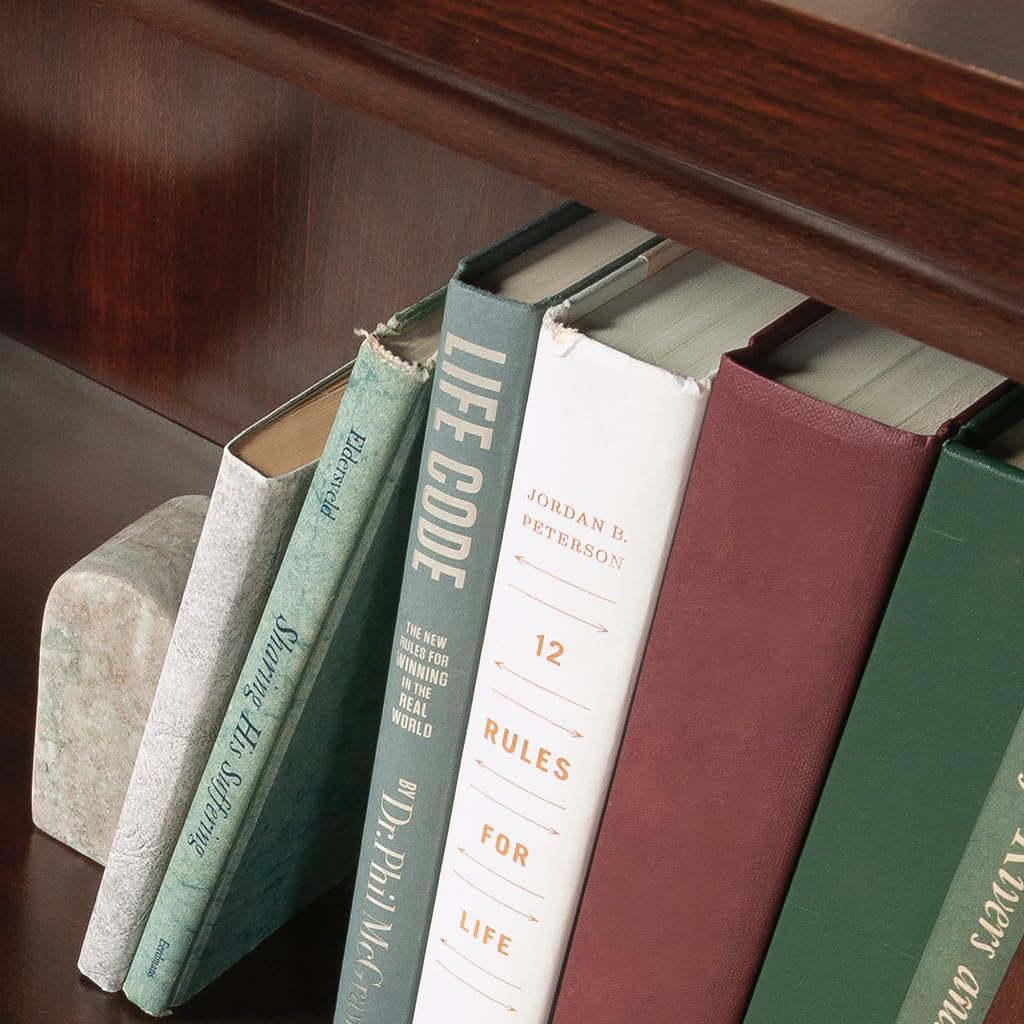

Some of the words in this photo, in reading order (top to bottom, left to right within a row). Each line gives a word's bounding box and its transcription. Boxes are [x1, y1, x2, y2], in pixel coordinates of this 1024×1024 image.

[434, 331, 507, 451] LIFE
[320, 428, 367, 521] Eldersveld
[411, 450, 483, 589] CODE
[527, 488, 605, 534] JORDAN
[612, 528, 629, 544] B.
[521, 514, 624, 571] PETERSON
[399, 635, 426, 660] RULES
[428, 650, 449, 668] FOR
[406, 621, 422, 640] THE
[423, 630, 447, 650] NEW
[535, 634, 565, 666] 12
[244, 613, 299, 711] Sharing
[396, 650, 449, 687] WINNING
[399, 692, 428, 718] REAL
[401, 675, 412, 691] IN
[414, 682, 432, 699] THE
[229, 710, 263, 758] His
[391, 707, 433, 738] WORLD
[484, 717, 570, 781] RULES
[187, 760, 243, 858] Suffering
[398, 778, 417, 799] BY
[375, 790, 414, 841] Dr.
[480, 823, 529, 867] FOR
[366, 839, 405, 912] Phil
[459, 911, 512, 956] LIFE
